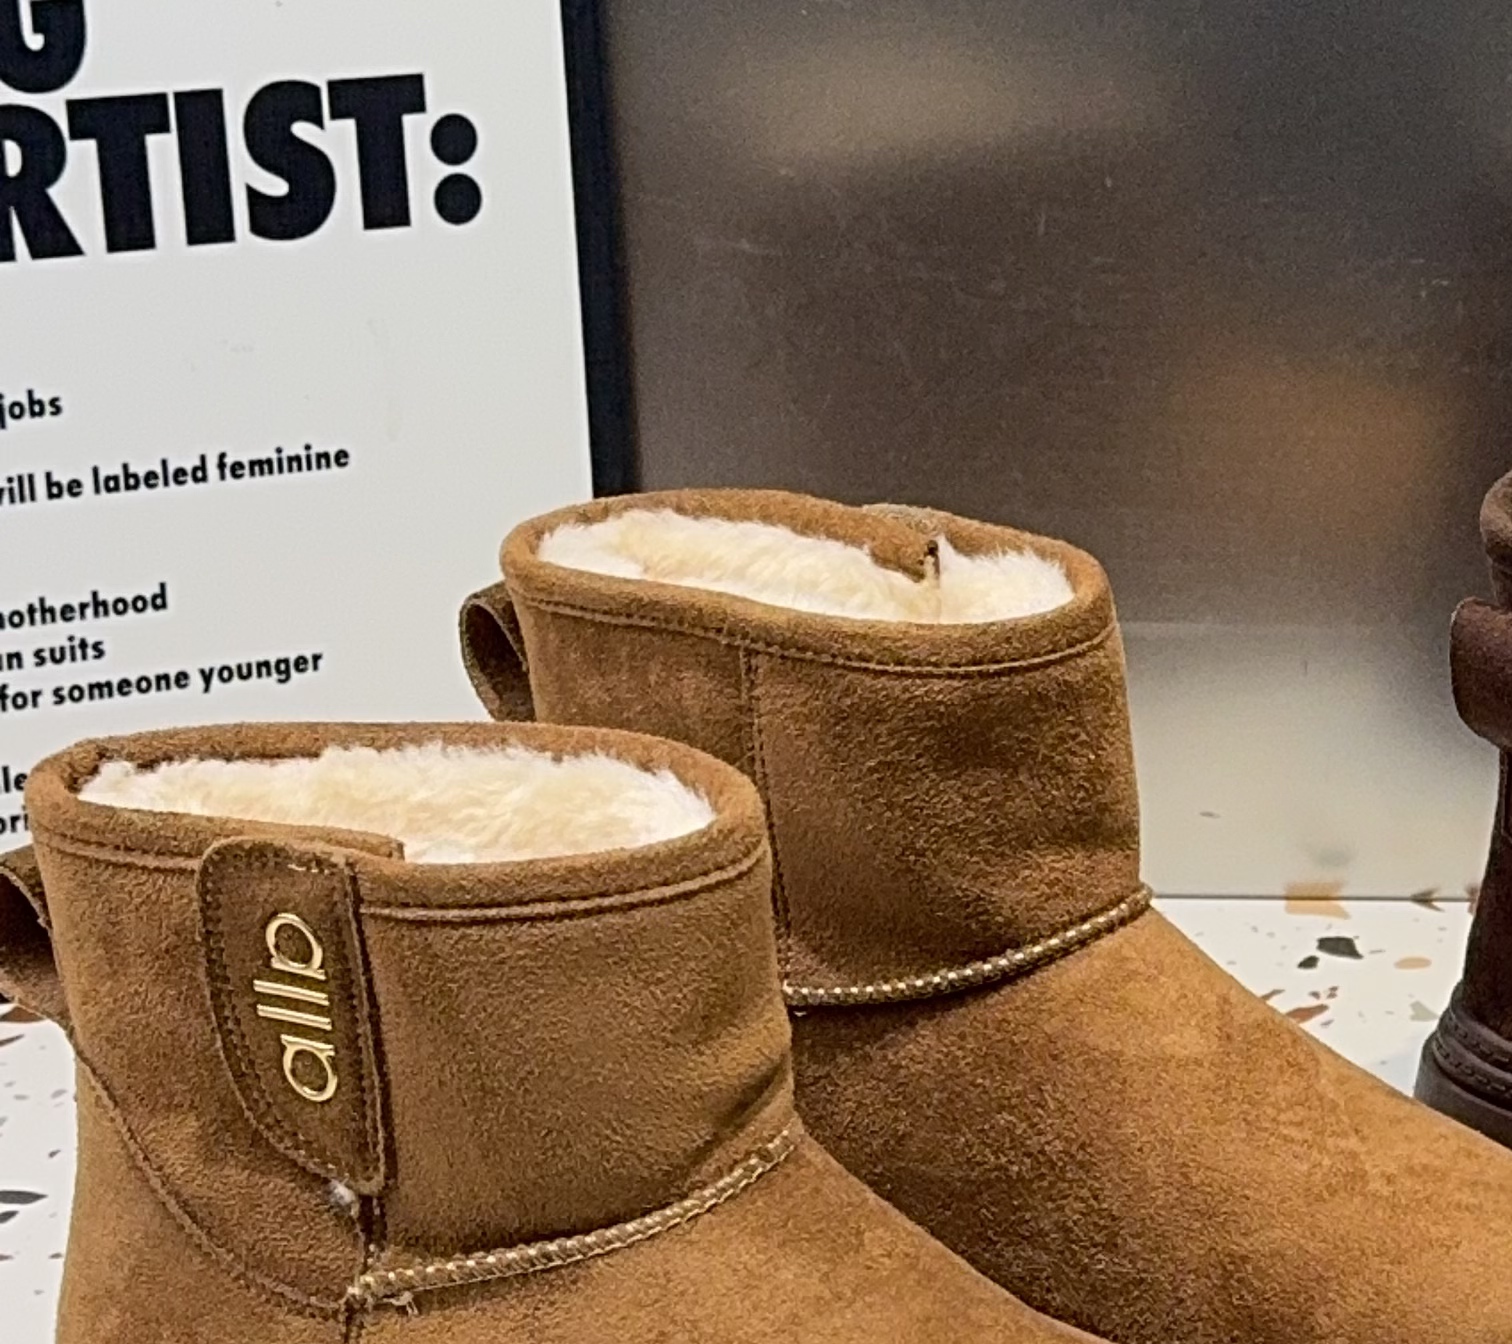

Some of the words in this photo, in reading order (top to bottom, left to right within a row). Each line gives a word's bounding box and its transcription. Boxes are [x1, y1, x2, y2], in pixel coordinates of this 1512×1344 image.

[0, 73, 482, 261] RTIST:
[0, 390, 62, 429] jobs
[46, 472, 82, 500] be
[92, 454, 207, 494] labeled
[217, 444, 349, 481] feminine
[34, 636, 104, 667] suits
[0, 684, 42, 712] for
[53, 671, 189, 705] someone
[200, 654, 322, 693] younger
